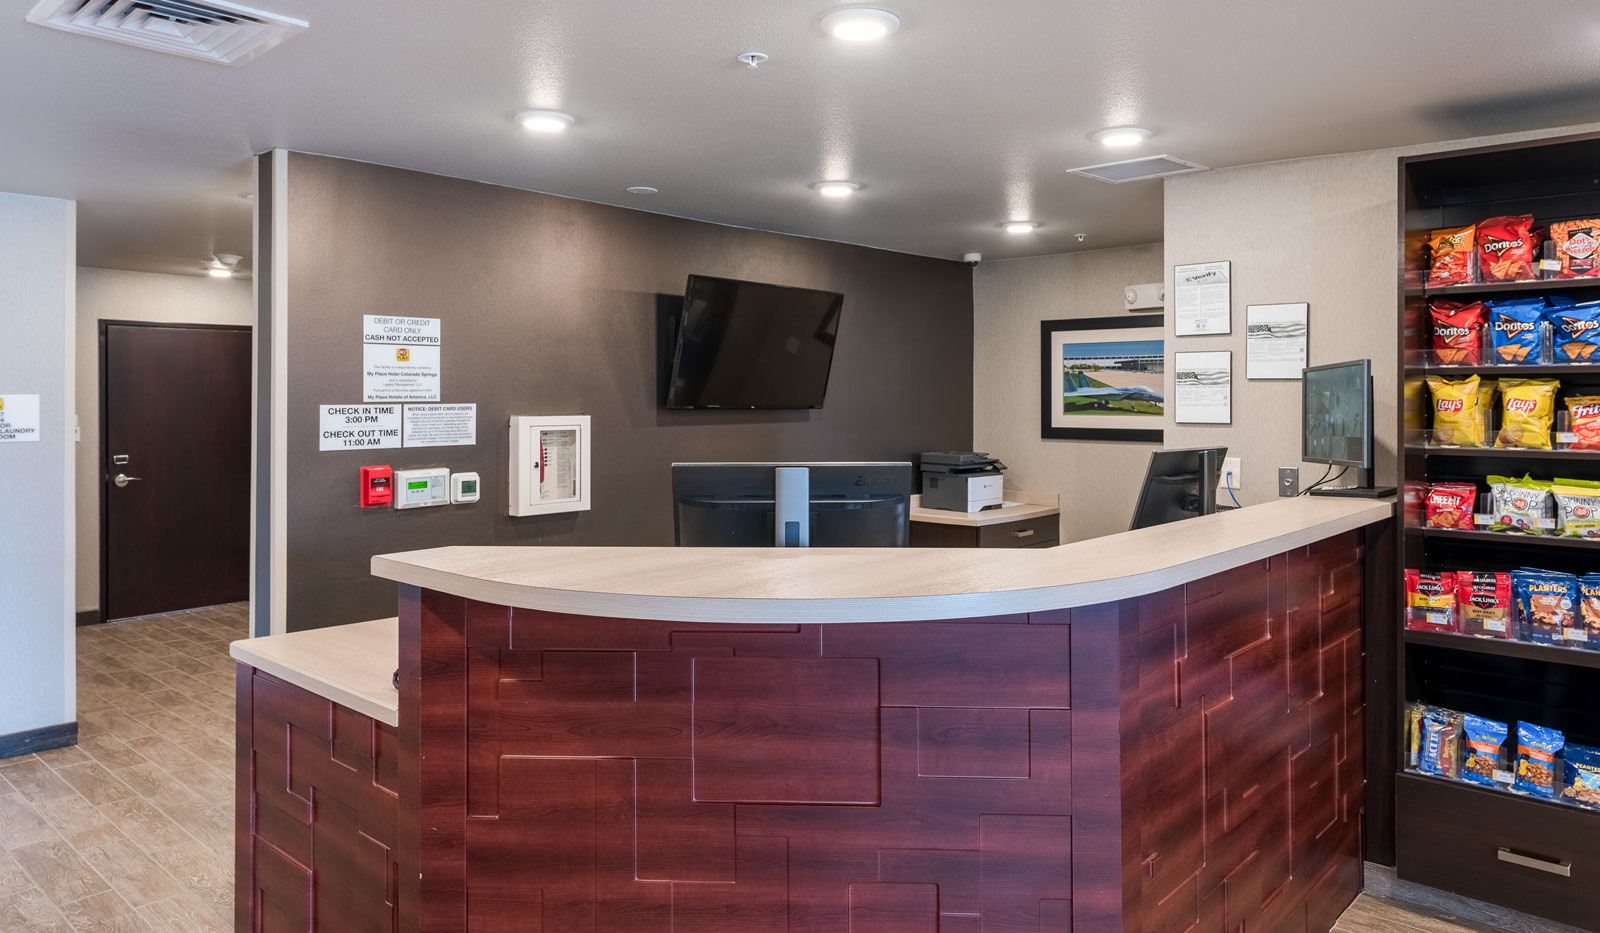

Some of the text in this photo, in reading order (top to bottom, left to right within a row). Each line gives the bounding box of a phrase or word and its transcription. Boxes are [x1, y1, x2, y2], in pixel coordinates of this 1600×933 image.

[1484, 238, 1524, 253] Doritos
[1570, 237, 1592, 245] Dot's
[1566, 245, 1596, 254] Pretzels
[1495, 322, 1535, 331] Doritos
[1561, 320, 1599, 332] Doritos
[1434, 327, 1470, 336] Doritos
[1438, 399, 1462, 412] Lay's
[1507, 398, 1535, 412] Lay's
[1563, 497, 1596, 506] SKINNY
[1564, 505, 1598, 519] POP
[1529, 585, 1567, 593] PLANTERS
